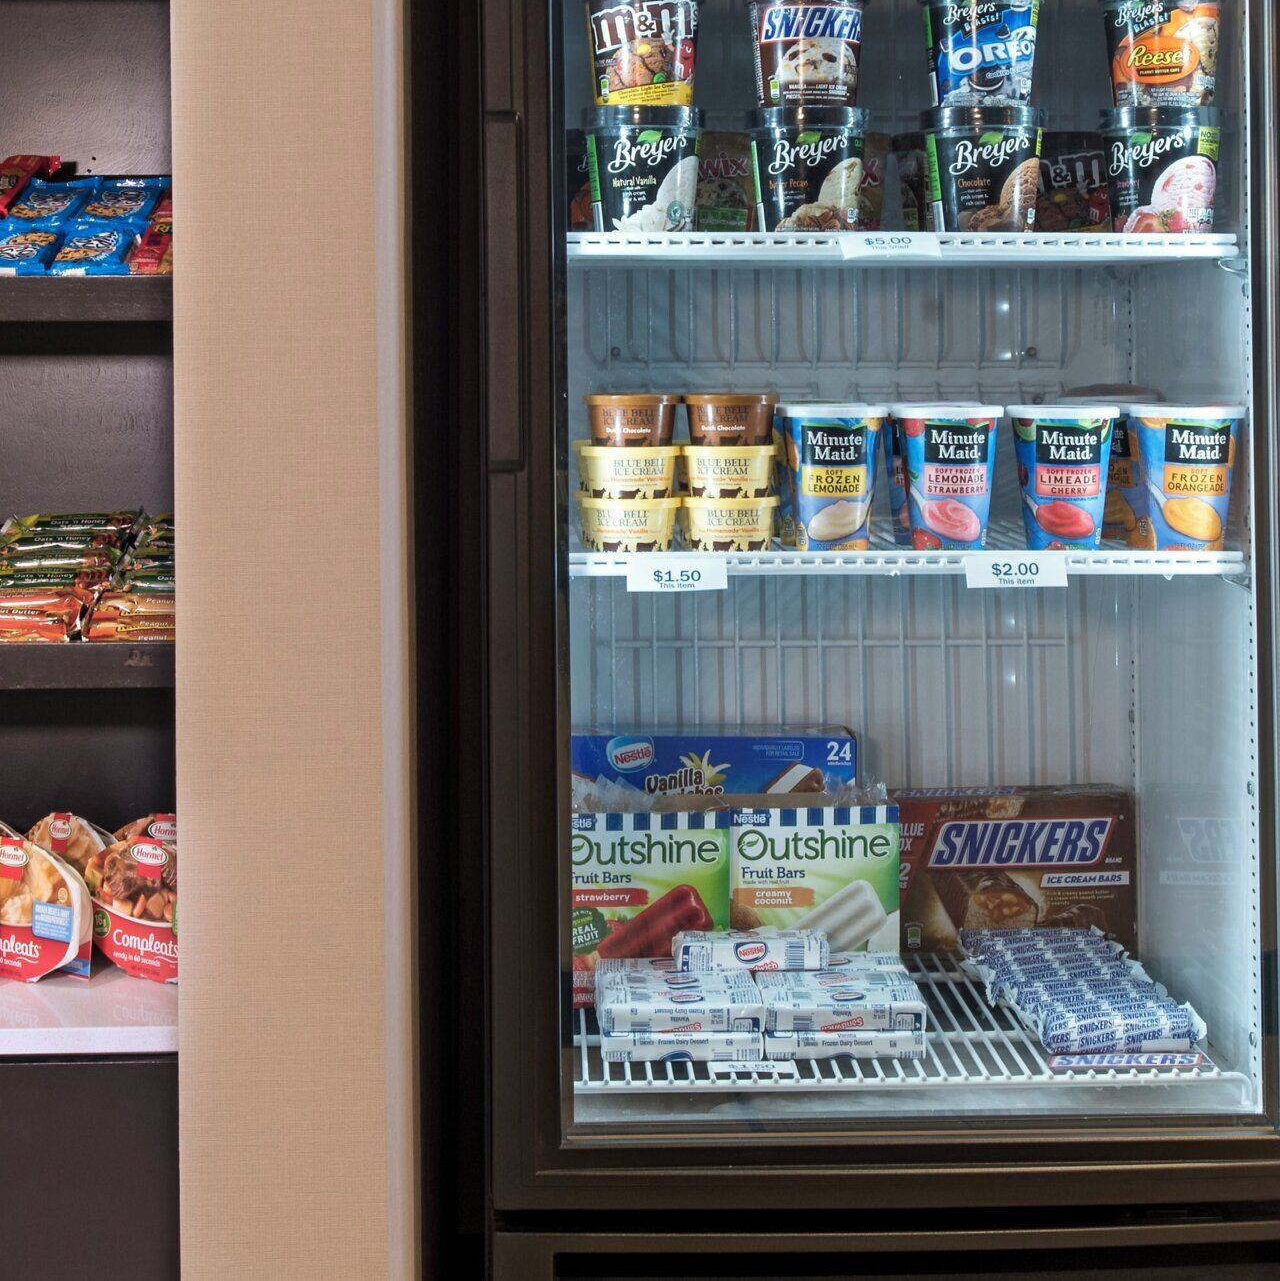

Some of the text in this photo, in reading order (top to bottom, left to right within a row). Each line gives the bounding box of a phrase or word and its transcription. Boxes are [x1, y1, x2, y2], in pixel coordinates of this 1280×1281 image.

[943, 2, 996, 25] Breyers
[951, 42, 1033, 68] OREO
[607, 133, 687, 173] Breyers
[949, 132, 1030, 175] Breyers
[1109, 131, 1184, 176] Breyers
[612, 176, 657, 187] Natural Vanilla
[958, 177, 991, 187] Chocolate
[807, 431, 862, 446] Minute
[931, 430, 985, 445] Minute
[814, 446, 855, 461] Maid
[938, 445, 978, 460] Maid
[613, 458, 665, 467] BLUE BELL
[614, 467, 664, 475] ICE CREAM
[809, 475, 860, 484] FROZEN
[928, 473, 985, 483] LEMONADE
[1040, 474, 1097, 484] LIMEADE
[808, 483, 860, 493] LEMONADE
[928, 485, 984, 494] STRAWBERRY
[1051, 486, 1087, 495] CHERRY
[1168, 482, 1224, 492] ORANGEADE
[992, 562, 1039, 576] $2.00
[653, 570, 701, 583] $1.50
[826, 742, 851, 761] 24
[646, 768, 705, 793] Vanilla
[738, 829, 890, 861] Outshine
[932, 821, 1108, 865] SNICKERS
[134, 849, 164, 860] Hormel
[741, 866, 806, 879] Fruit Bars
[1047, 874, 1122, 884] ICE CREAM BARS
[575, 894, 630, 902] strawberry
[755, 890, 791, 899] creamy
